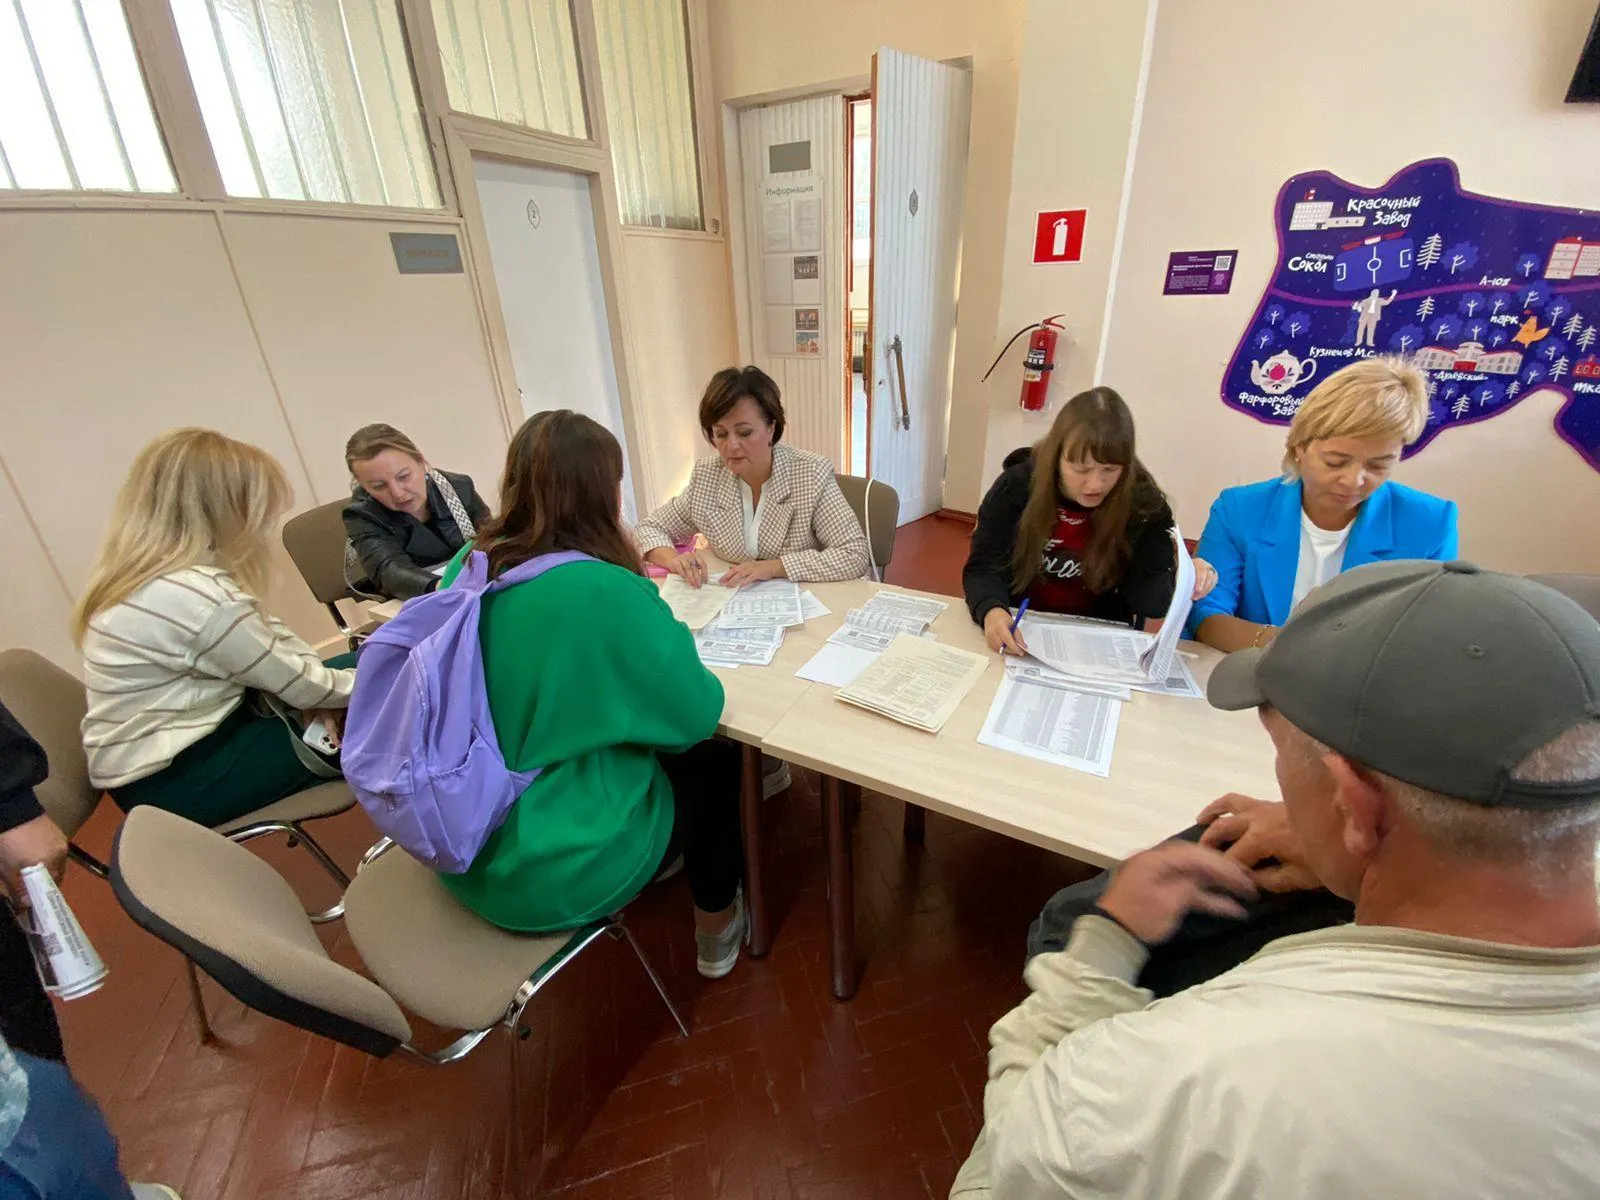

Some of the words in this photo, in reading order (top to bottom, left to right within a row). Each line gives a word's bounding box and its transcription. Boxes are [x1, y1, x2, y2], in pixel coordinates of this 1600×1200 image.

[765, 184, 814, 197] Информация
[1347, 195, 1421, 213] Красочный
[1373, 210, 1411, 228] Завод
[1288, 256, 1328, 273] Сокол
[1490, 315, 1520, 327] парк
[1309, 345, 1354, 358] Кузнецов
